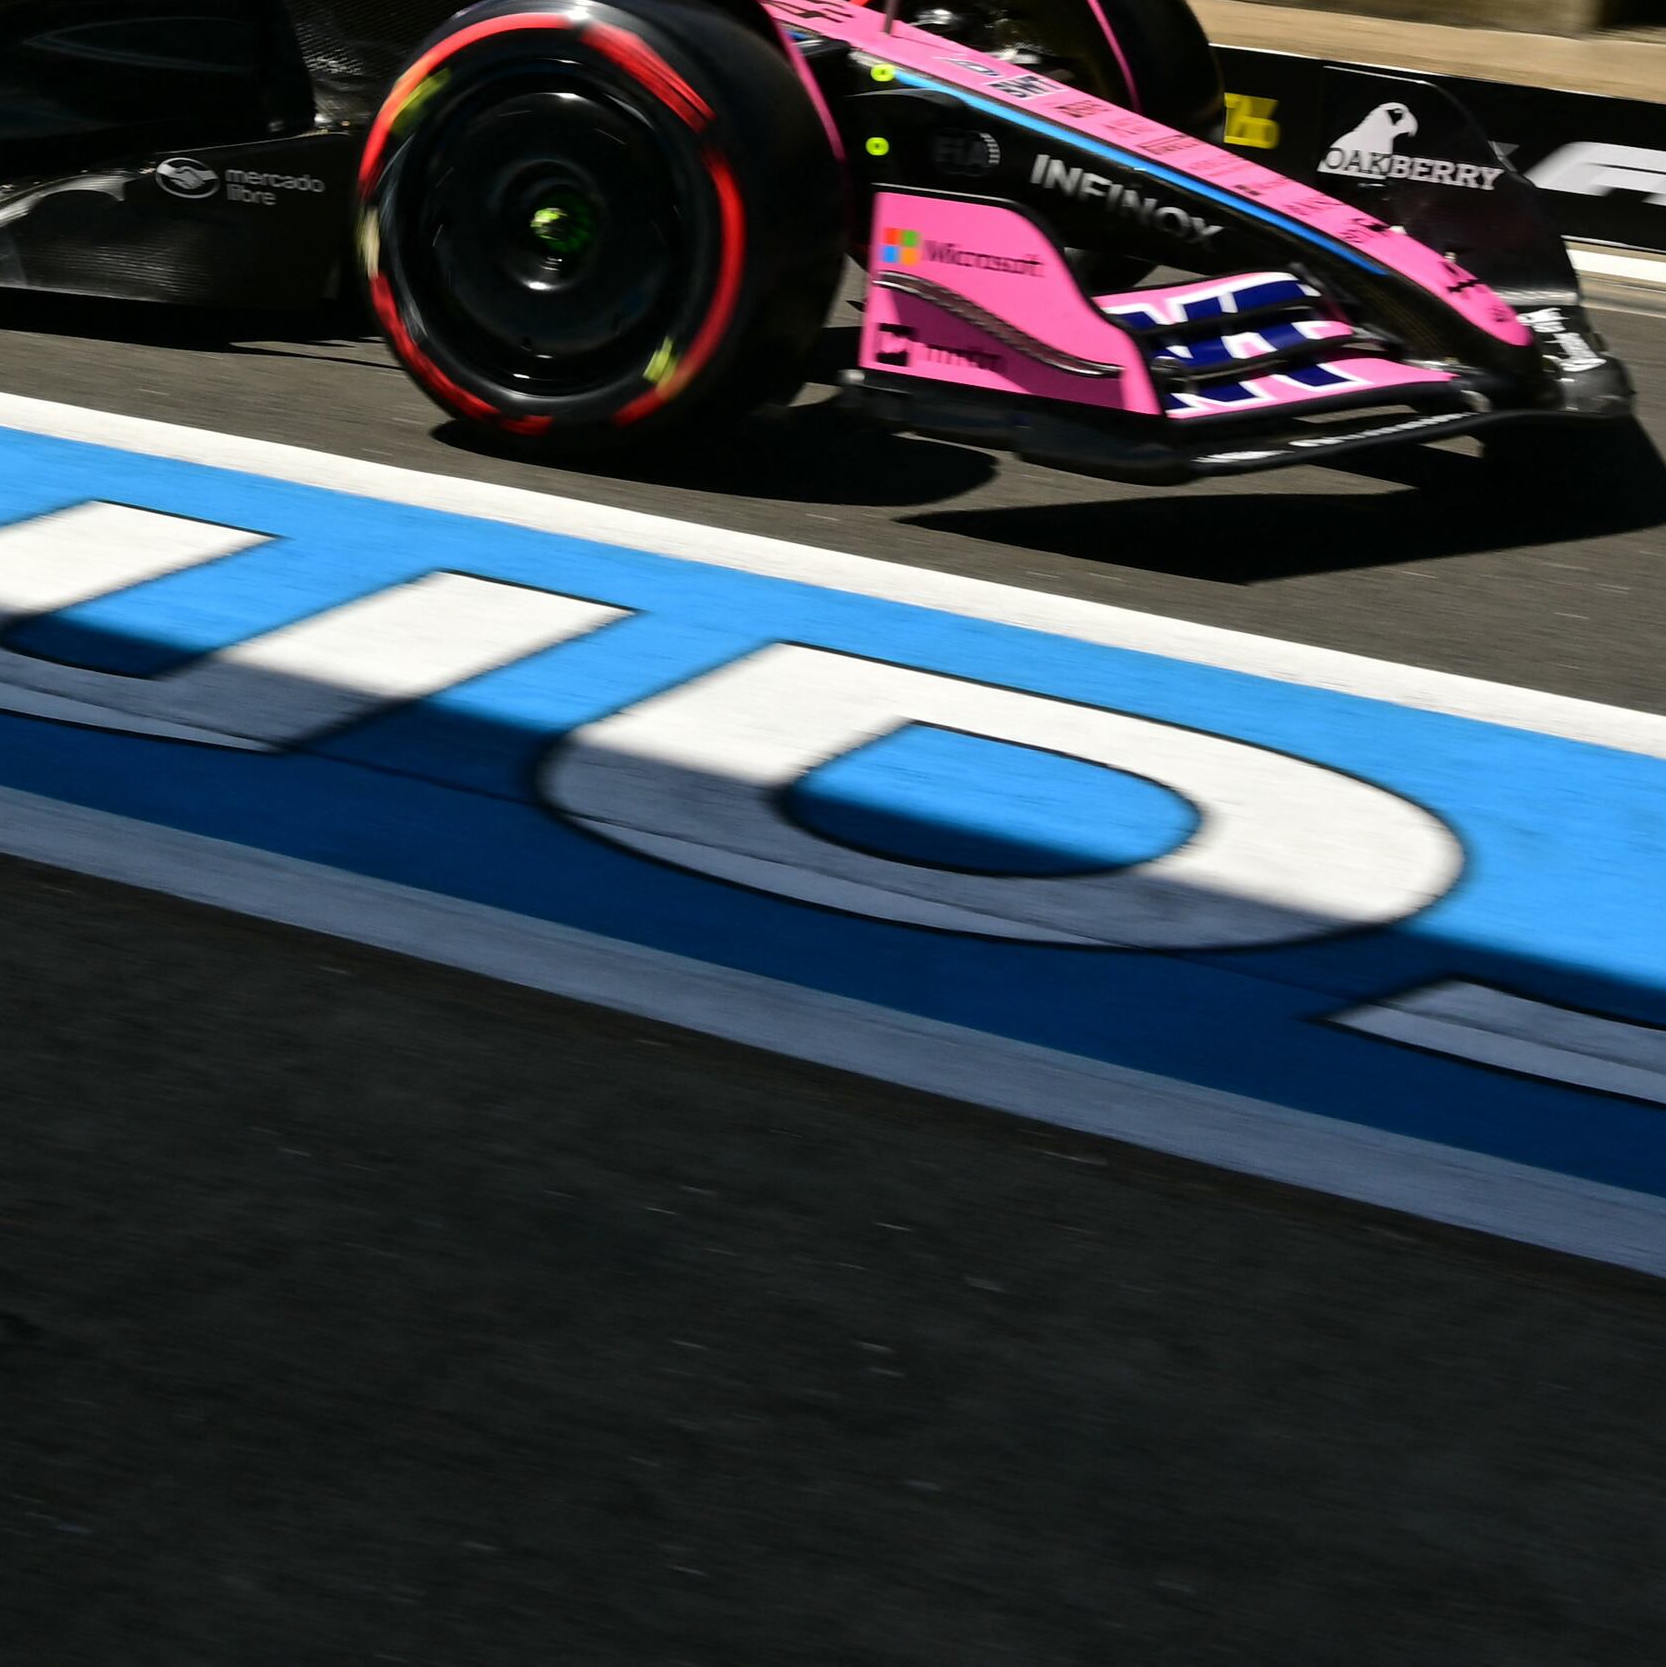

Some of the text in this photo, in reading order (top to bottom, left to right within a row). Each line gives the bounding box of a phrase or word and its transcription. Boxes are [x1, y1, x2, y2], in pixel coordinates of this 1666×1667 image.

[225, 169, 325, 193] mercado
[1319, 148, 1504, 191] OAKBERRY
[227, 184, 276, 205] libre
[1030, 154, 1225, 244] INFINOX
[923, 240, 1044, 277] Microsoft
